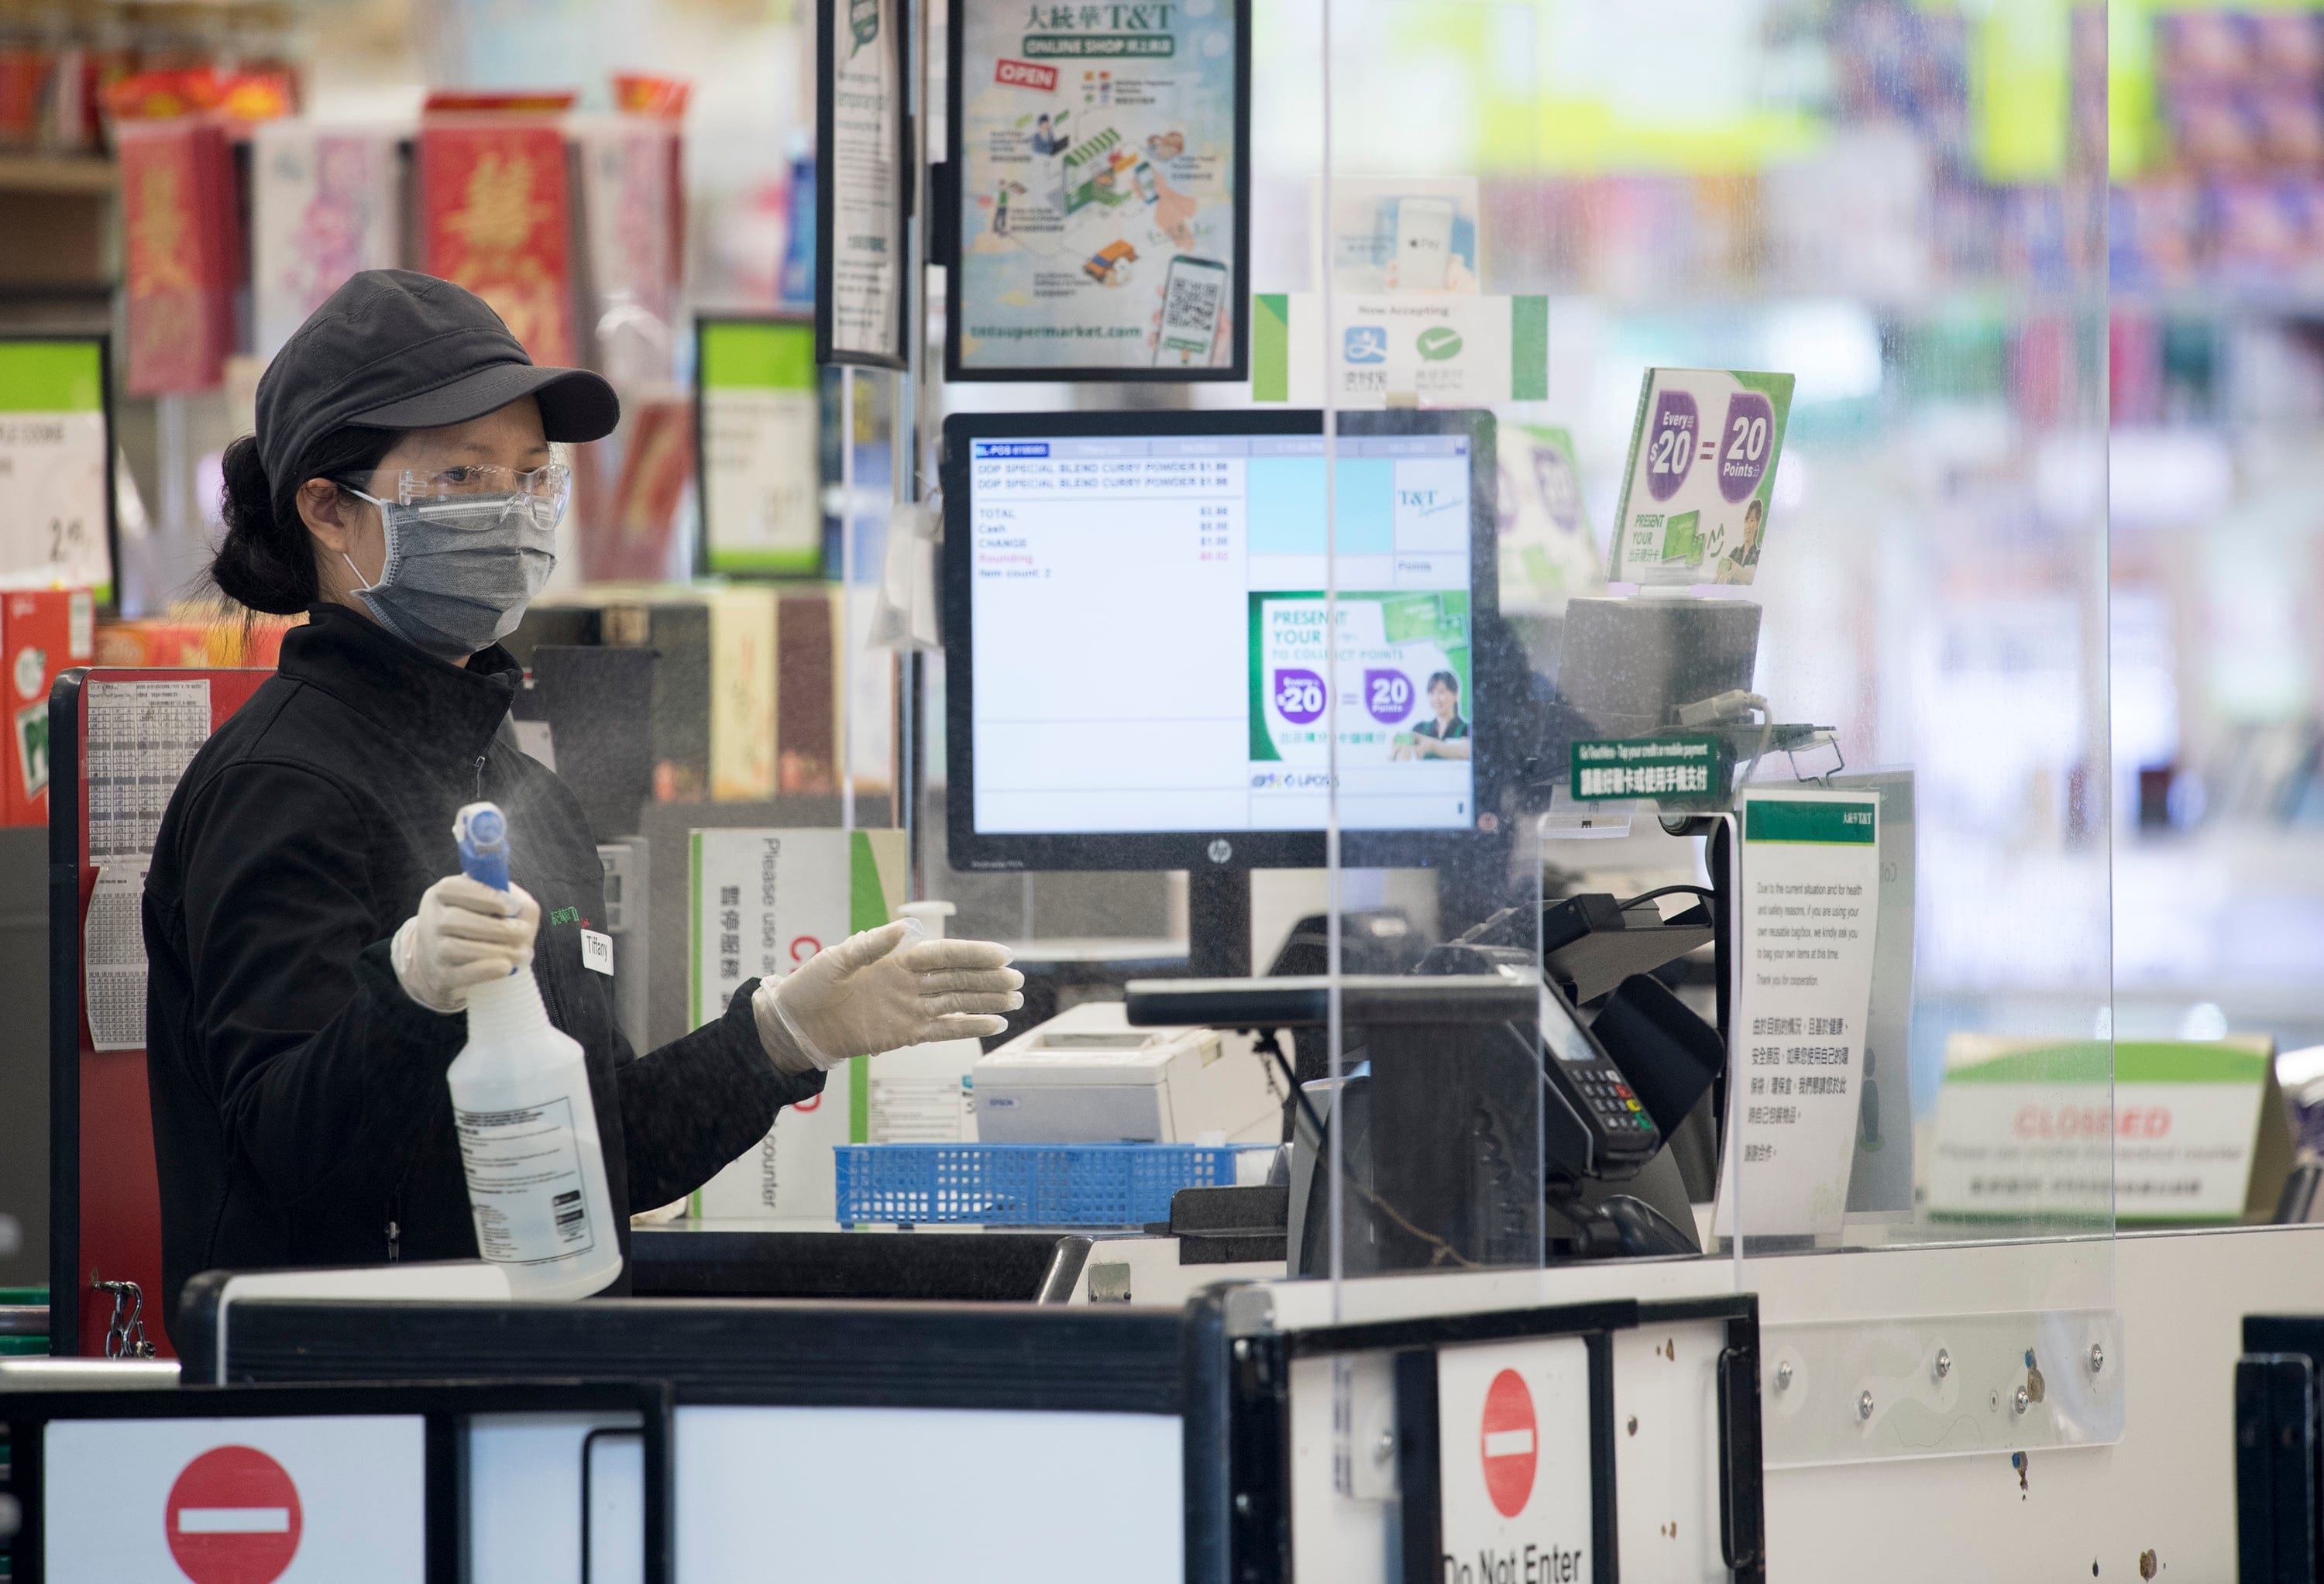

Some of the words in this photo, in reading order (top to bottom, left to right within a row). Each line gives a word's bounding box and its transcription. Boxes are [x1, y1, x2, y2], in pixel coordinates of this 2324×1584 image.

[1102, 4, 1176, 29] T&T
[1026, 40, 1081, 53] ONLINE
[1084, 40, 1123, 53] SHOP
[999, 64, 1054, 87] OPEN
[1663, 411, 1687, 430] Every
[1649, 430, 1691, 474] $20
[1727, 416, 1767, 461] 20
[1006, 464, 1054, 473] SPECIAL
[1060, 464, 1098, 473] BLEND
[1102, 463, 1141, 472] CURRY
[1146, 463, 1196, 472] POWDER
[1723, 462, 1754, 478] Points
[1006, 479, 1054, 488] SPECIAL
[1060, 479, 1098, 488] BLEND
[1102, 478, 1141, 487] CURRY
[1146, 478, 1196, 486] POWDER
[1397, 490, 1438, 506] T&T
[980, 508, 1015, 518] TOTAL
[978, 524, 1006, 533] Cash
[1634, 514, 1665, 528] PRESENT
[978, 539, 1027, 548] CHANGE
[1632, 531, 1653, 545] YOUR
[978, 554, 1033, 564] Rounding
[1273, 631, 1322, 644] YOUR
[1277, 686, 1322, 713] $20
[1372, 676, 1408, 705] 20
[762, 837, 780, 907] Please
[1757, 881, 1767, 894] Due
[1769, 882, 1774, 894] to
[1776, 882, 1784, 894] the
[1785, 882, 1803, 895] current
[1804, 883, 1826, 895] situation
[1827, 884, 1837, 895] and
[1838, 884, 1846, 895] for
[1846, 884, 1863, 896] health
[1758, 905, 1767, 916] and
[1769, 905, 1783, 919] safety
[1811, 906, 1821, 919] you
[1822, 907, 1831, 917] are
[1832, 905, 1847, 920] using
[1847, 907, 1859, 920] your
[762, 912, 775, 949] use
[1757, 927, 1768, 937] own
[1769, 926, 1790, 937] reusable
[1813, 928, 1821, 938] we
[1822, 926, 1837, 940] kindly
[1838, 927, 1848, 938] ask
[1848, 929, 1858, 941] you
[586, 935, 608, 962] Tiffany
[1762, 949, 1773, 962] bag
[1773, 950, 1785, 962] your
[1786, 950, 1796, 959] own
[1796, 949, 1810, 959] items
[1810, 949, 1817, 959] at
[1817, 949, 1826, 959] this
[1756, 974, 1771, 985] Thank
[1772, 975, 1781, 988] you
[762, 1133, 779, 1208] counter
[1444, 1555, 1470, 1584] Do
[1480, 1549, 1516, 1584] Not
[1525, 1543, 1581, 1584] Enter
